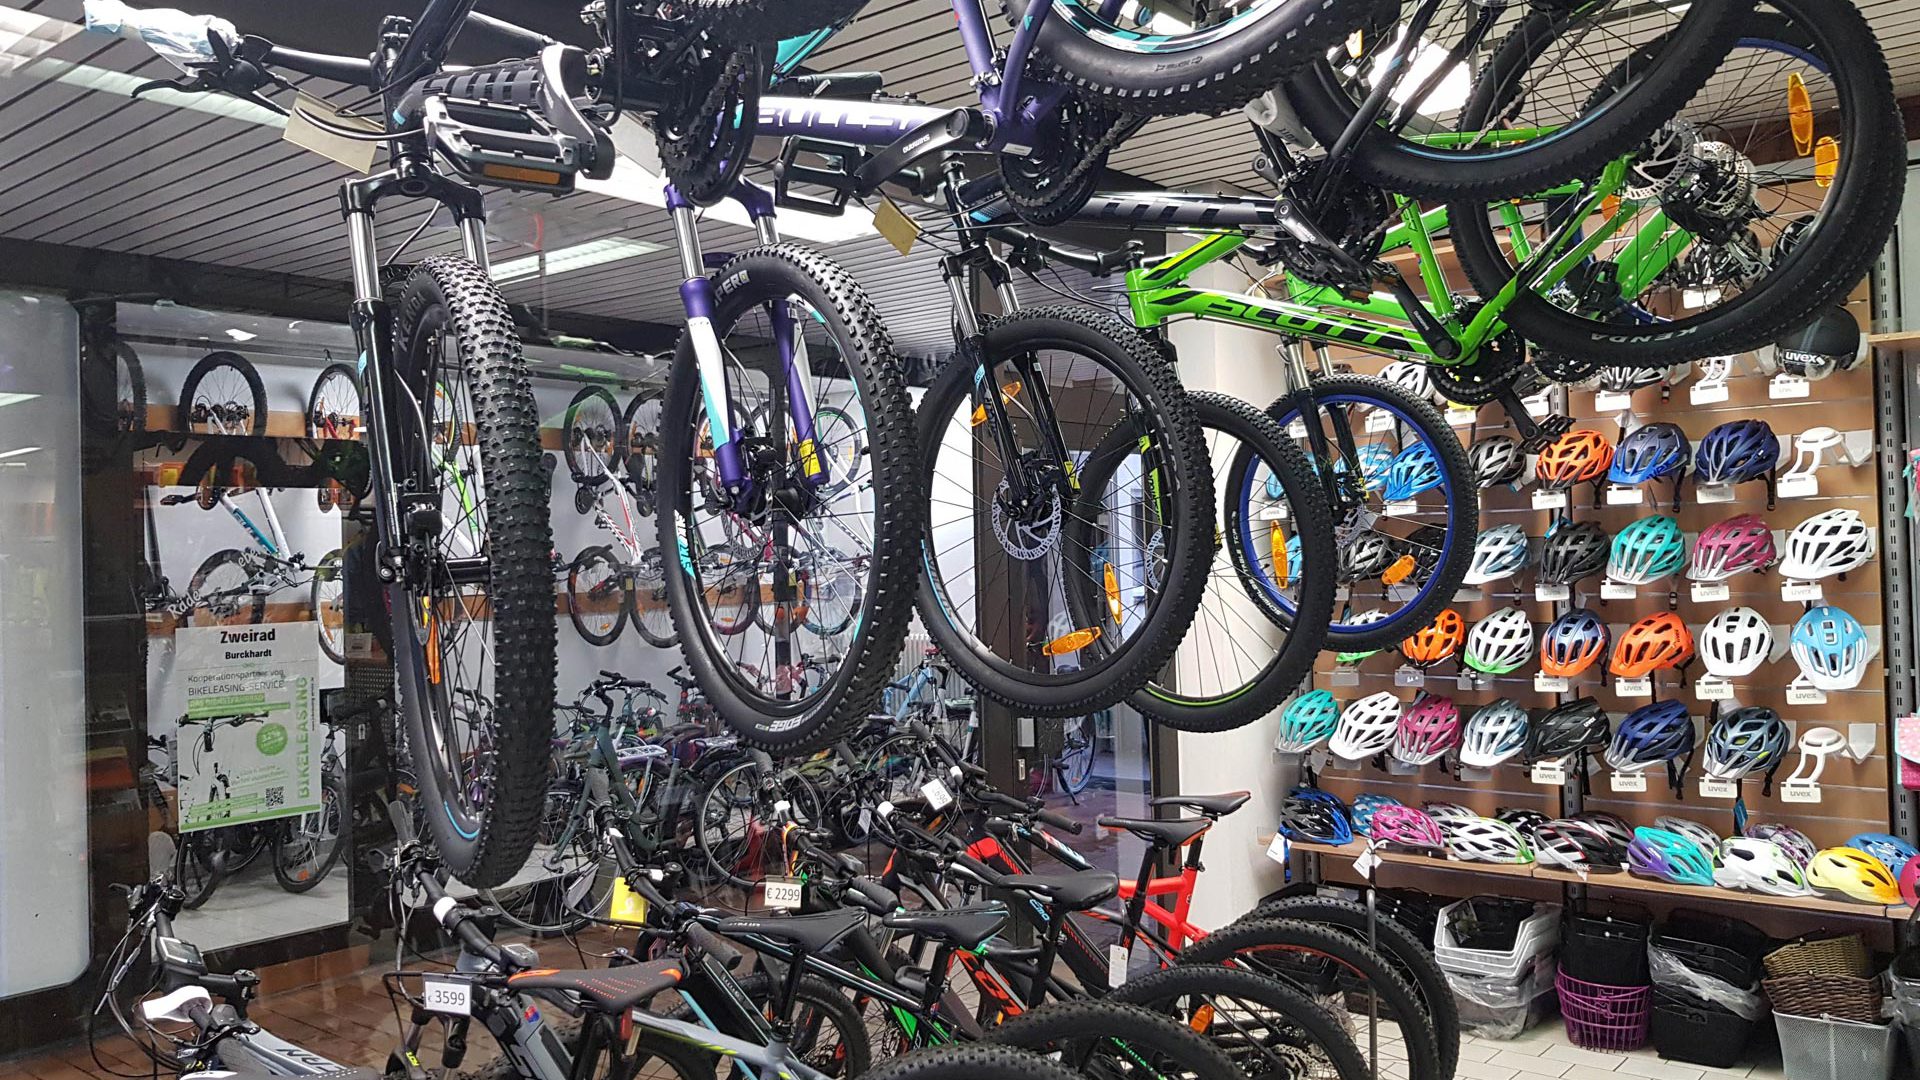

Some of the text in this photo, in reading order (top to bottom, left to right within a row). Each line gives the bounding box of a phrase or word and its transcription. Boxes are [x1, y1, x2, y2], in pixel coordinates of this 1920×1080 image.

[714, 270, 750, 308] PERO
[1591, 325, 1699, 343] KENDA
[1786, 351, 1817, 364] uvex
[220, 628, 276, 644] Zweirad
[225, 649, 272, 660] Burckhardt
[769, 714, 803, 733] EDGE
[296, 677, 310, 798] BIKELEASING
[1707, 785, 1727, 793] uvex
[767, 887, 801, 901] € 2299
[434, 990, 465, 1006] 3599
